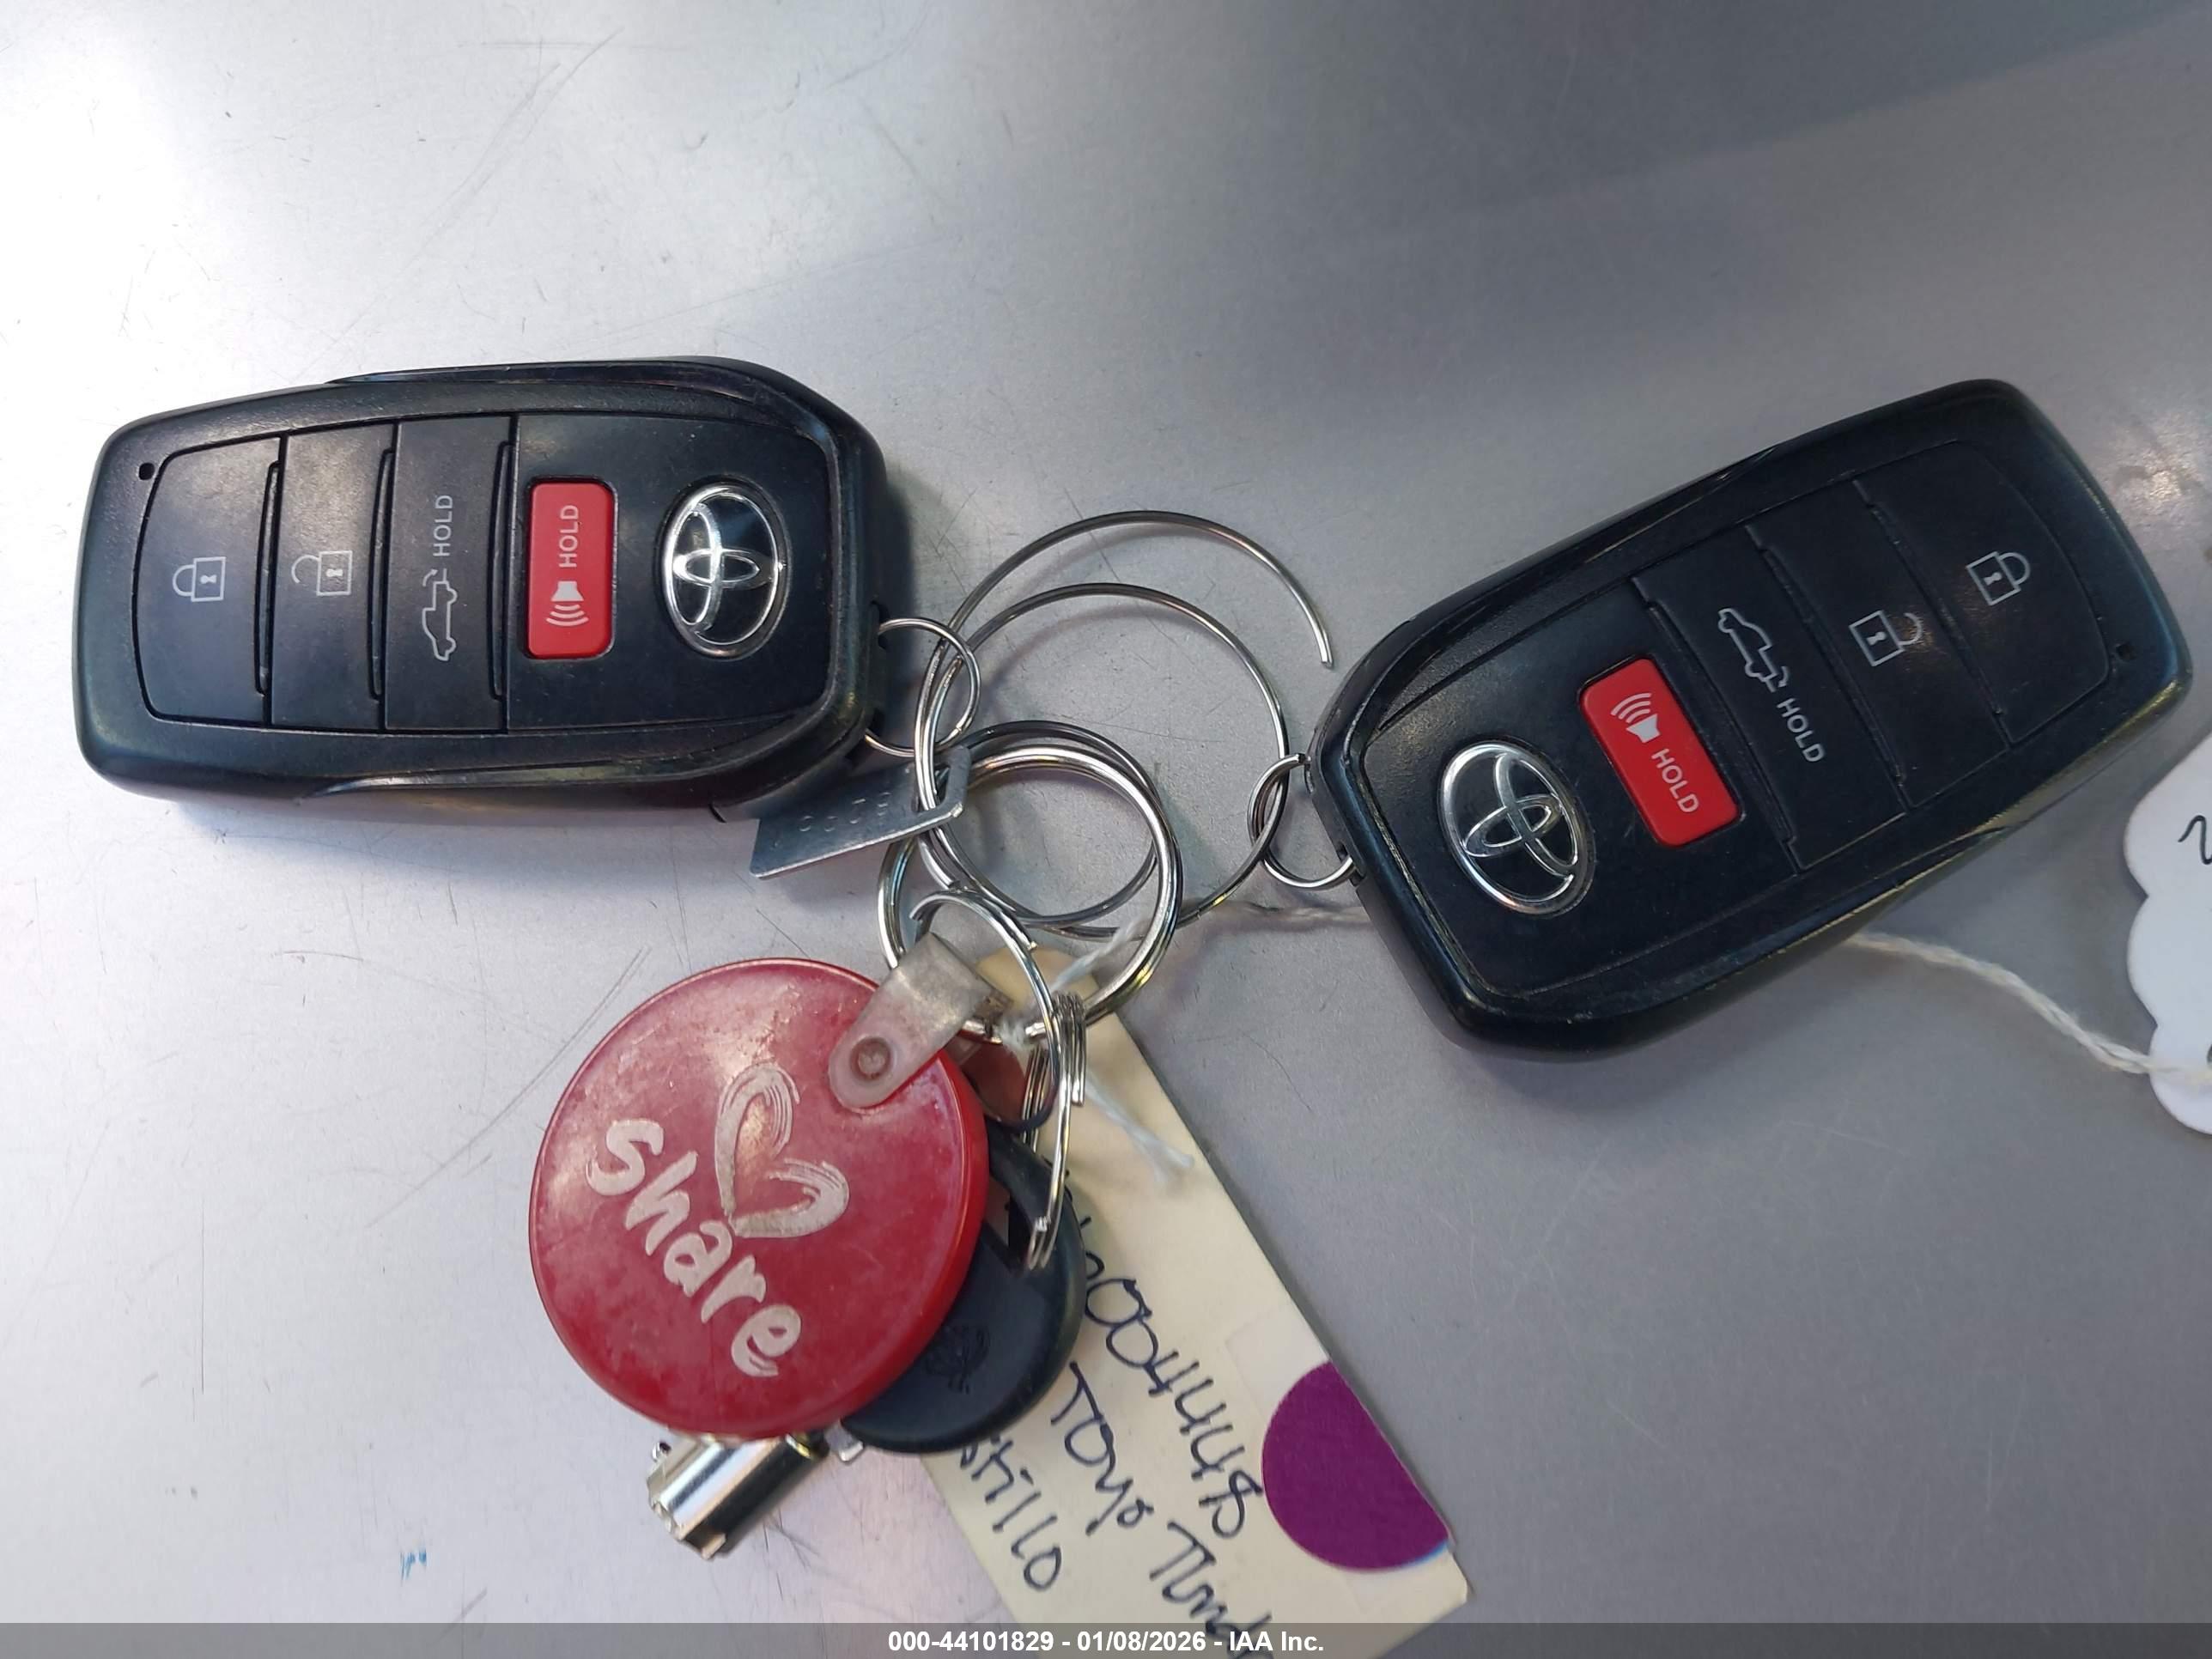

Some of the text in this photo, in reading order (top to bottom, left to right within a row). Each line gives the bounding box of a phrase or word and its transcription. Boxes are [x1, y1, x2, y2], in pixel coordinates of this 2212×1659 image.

[433, 495, 453, 557] HOLD
[558, 505, 579, 568] HOLD
[1776, 696, 1826, 763] HOLD
[1650, 748, 1700, 813] HOLD
[585, 1117, 802, 1377] Share
